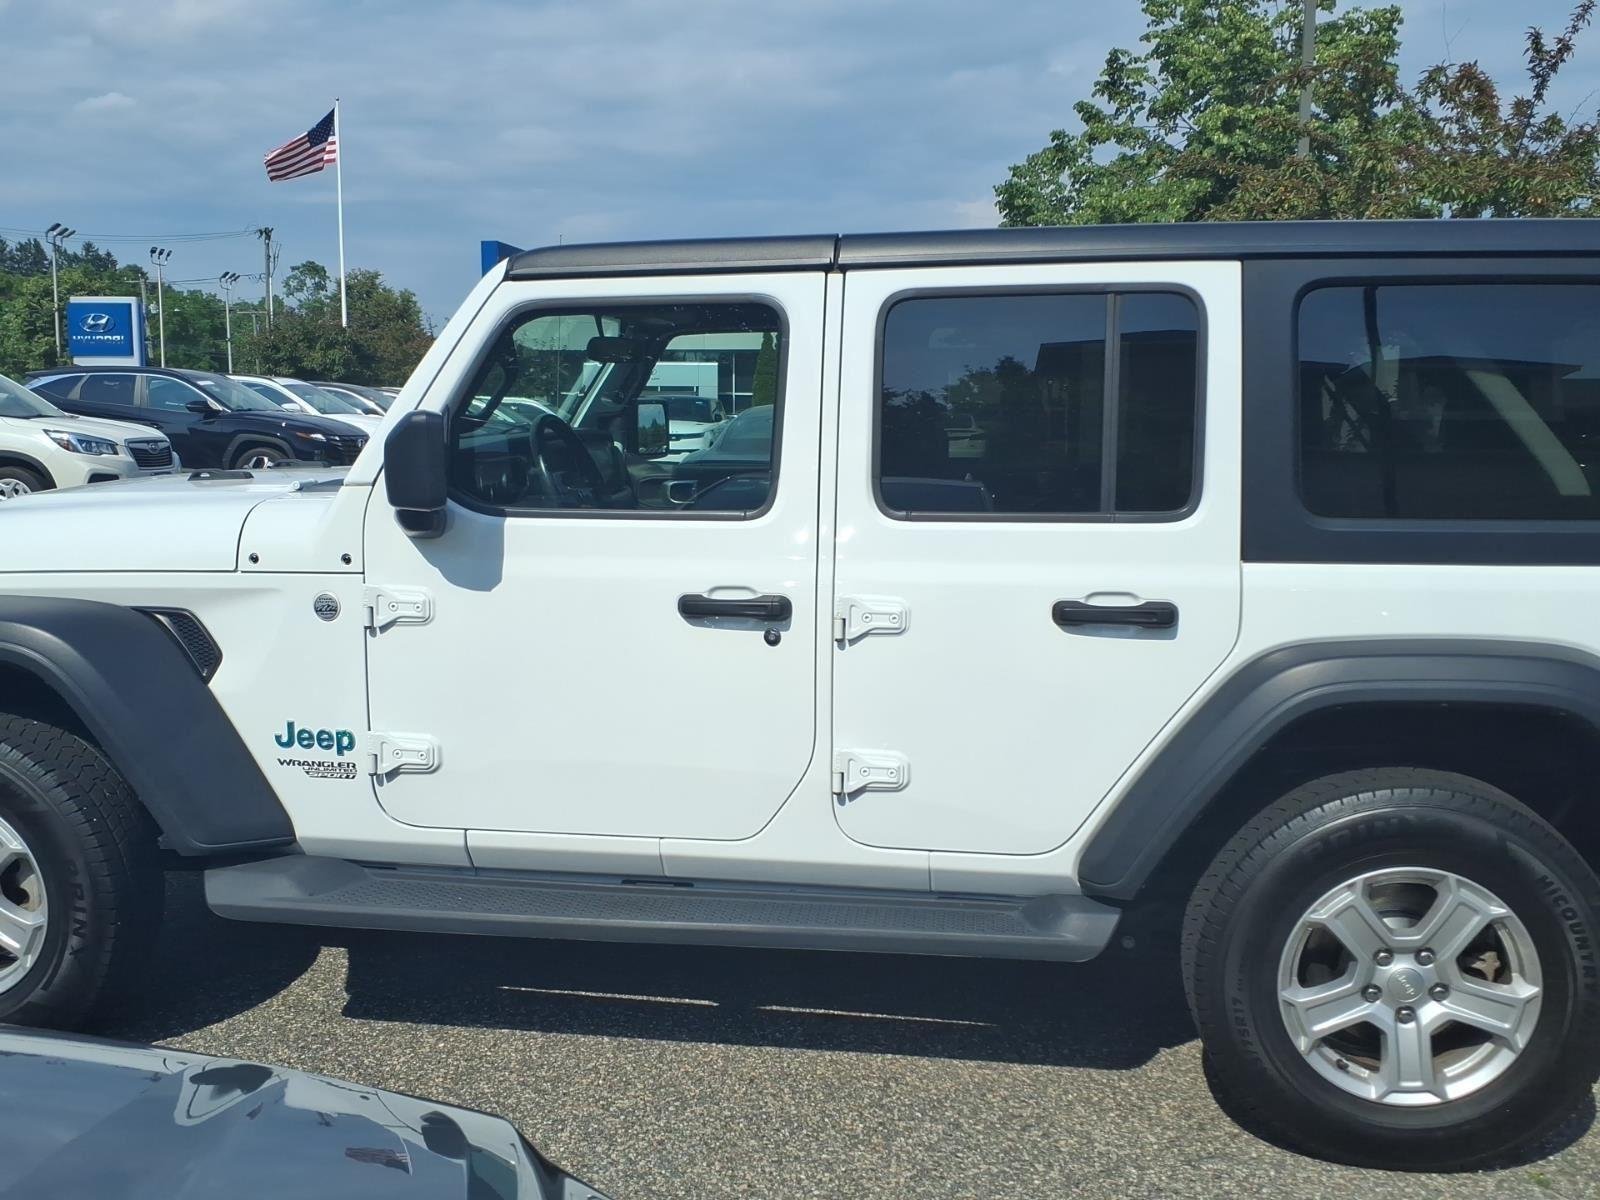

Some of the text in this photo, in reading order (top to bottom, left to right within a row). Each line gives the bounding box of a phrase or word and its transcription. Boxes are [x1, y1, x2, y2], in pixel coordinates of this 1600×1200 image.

[274, 720, 356, 757] Jeep
[277, 758, 357, 769] WRANGLER
[308, 771, 357, 779] SPORT
